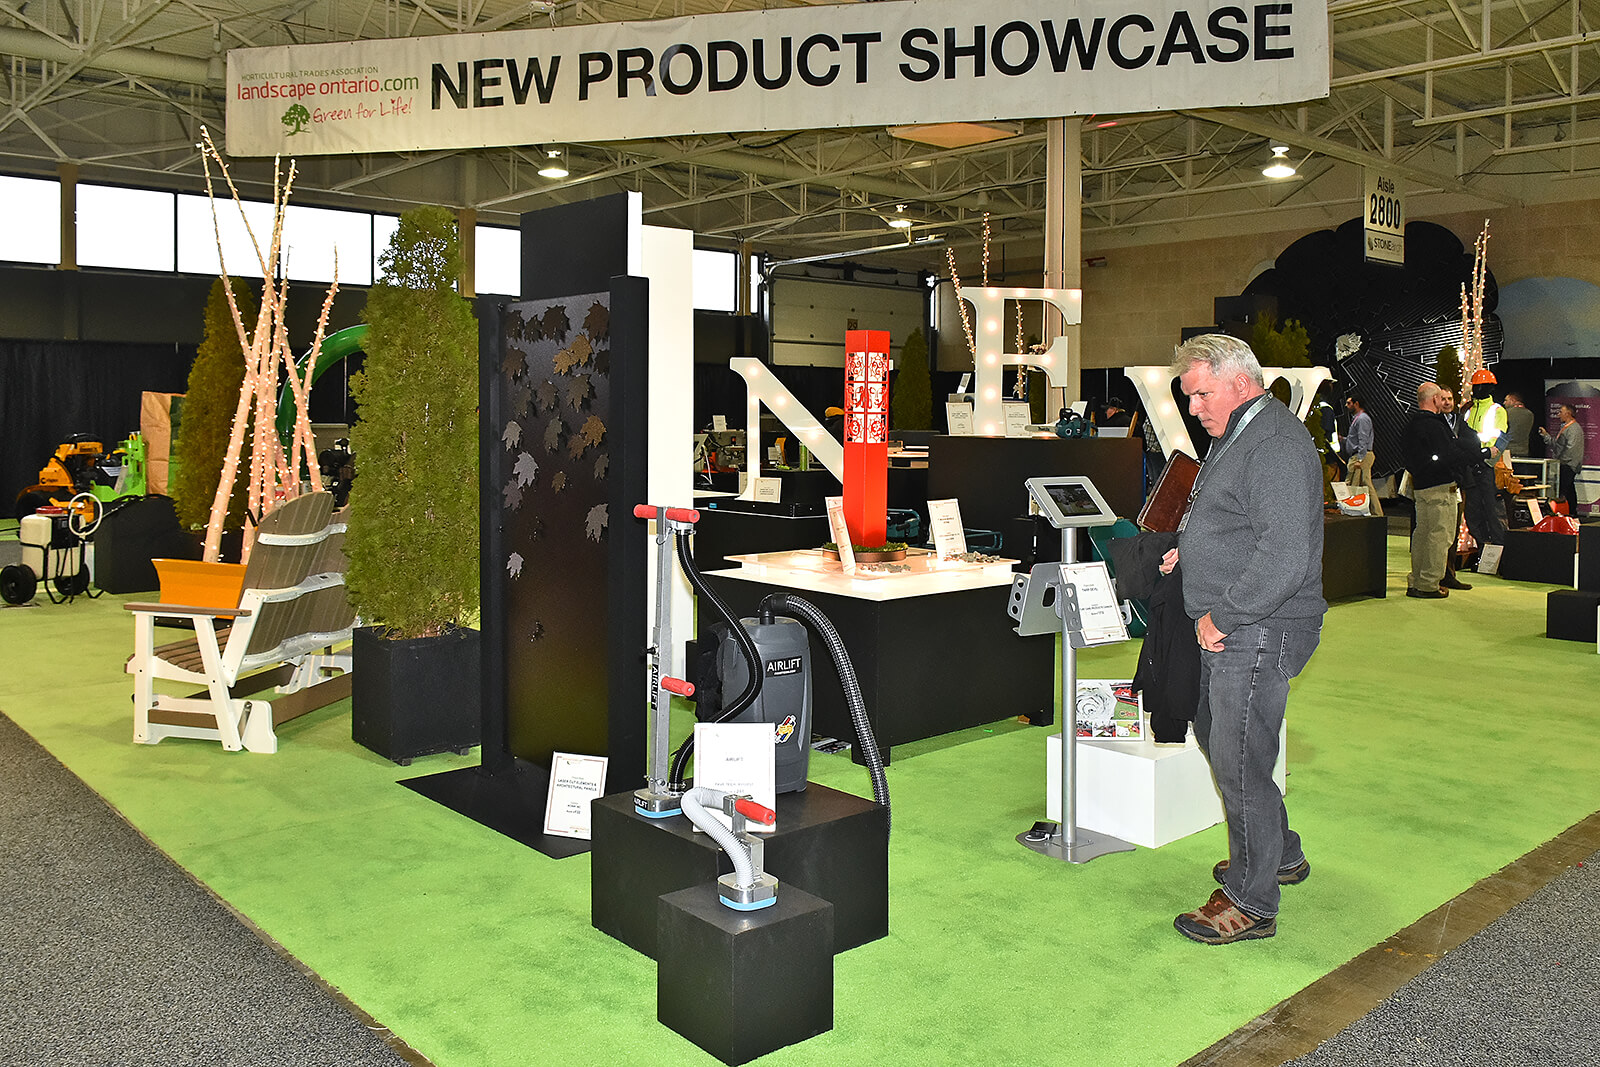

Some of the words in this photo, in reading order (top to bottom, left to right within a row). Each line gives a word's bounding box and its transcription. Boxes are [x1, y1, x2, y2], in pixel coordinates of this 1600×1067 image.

[431, 55, 561, 110] NEW
[578, 31, 881, 101] PRODUCT
[898, 3, 1295, 85] SHOWCASE
[241, 71, 298, 81] HORTICULTURAL
[299, 69, 329, 77] TRADES
[331, 66, 379, 76] ASSOCIATION
[237, 81, 316, 100] landscape
[319, 76, 419, 95] ontario.com
[313, 107, 352, 123] Green
[355, 102, 377, 120] for
[380, 96, 413, 117] Life!
[1377, 176, 1395, 194] Aisle
[1370, 193, 1401, 229] 2800
[767, 657, 801, 672] AIRLIFT
